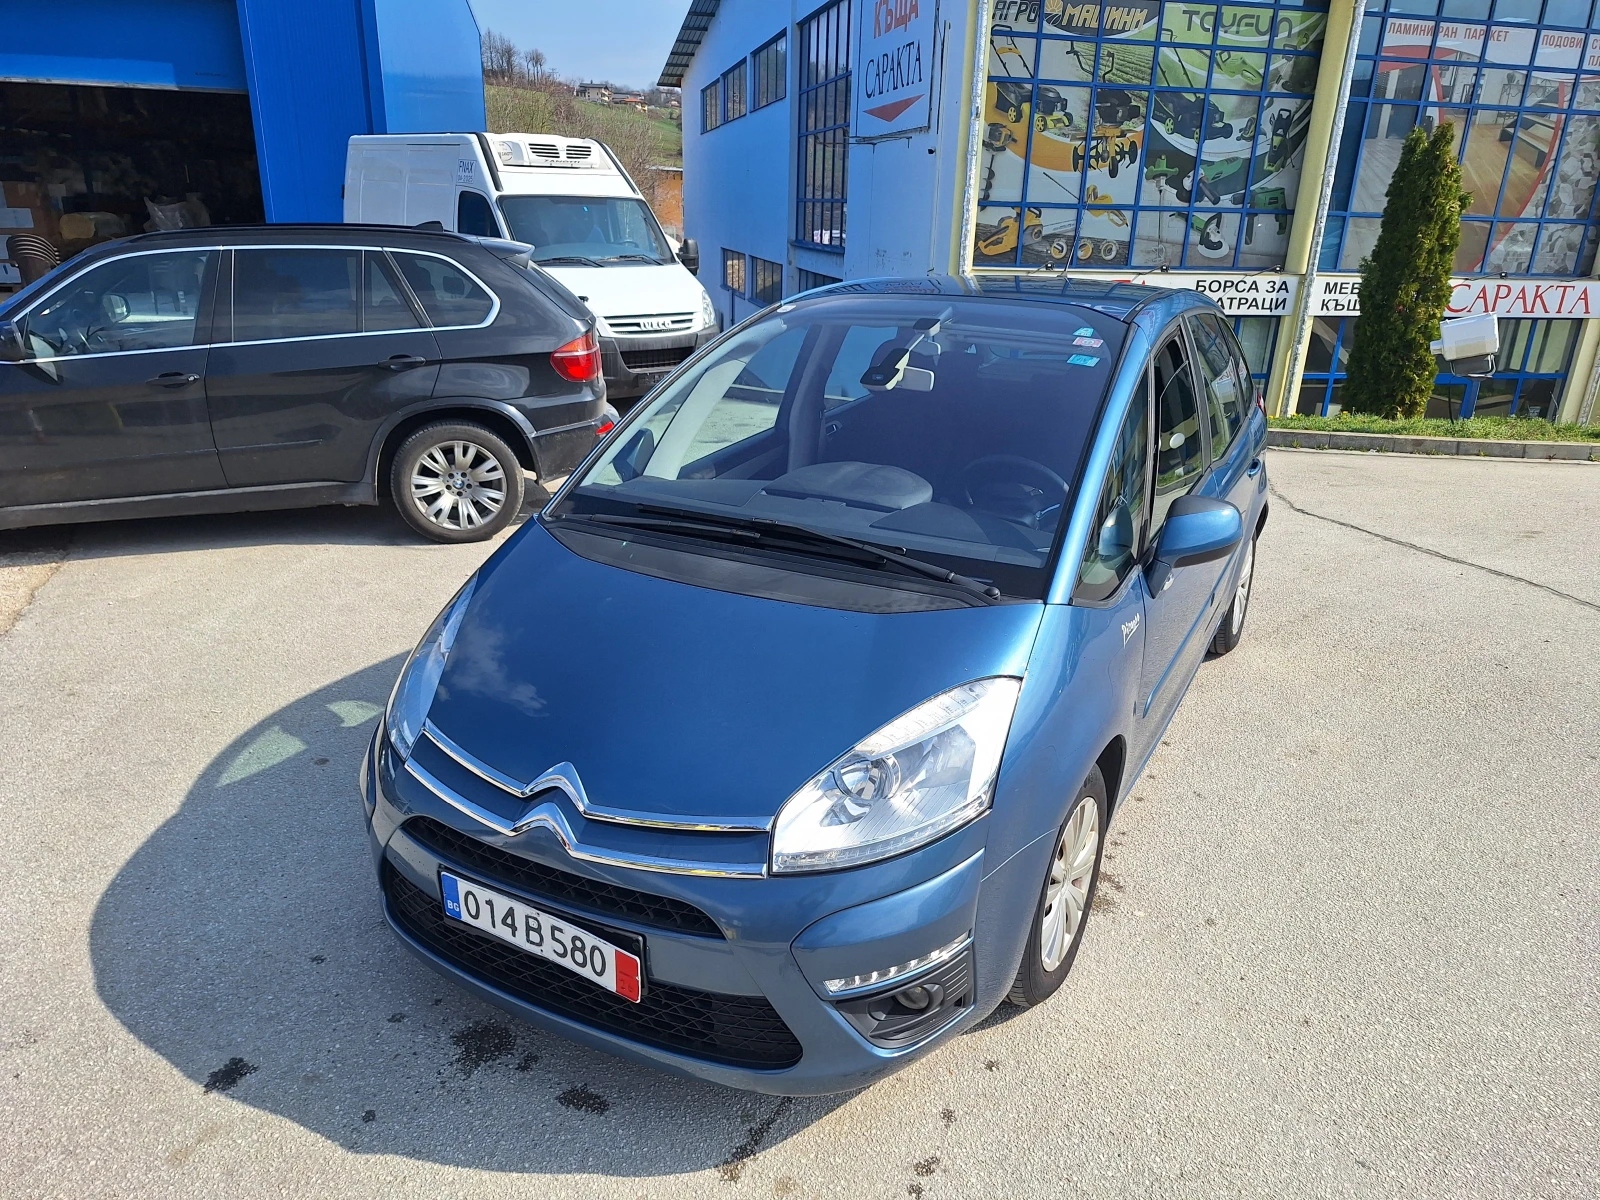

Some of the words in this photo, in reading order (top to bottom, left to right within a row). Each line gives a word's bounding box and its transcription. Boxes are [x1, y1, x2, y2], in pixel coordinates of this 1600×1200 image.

[992, 0, 1040, 23] АГРО
[1061, 3, 1148, 31] МАШИНИ
[1388, 22, 1458, 39] ЛАМИНИРАН
[1463, 27, 1510, 42] ПАРКЕТ
[1541, 34, 1583, 49] ПОДОВИ
[865, 40, 922, 98] САРАКТА
[1195, 279, 1260, 294] БОРСА
[1265, 280, 1290, 294] ЗА
[1216, 297, 1287, 313] АТРАЦИ
[1444, 283, 1591, 315] САРАКТА
[640, 319, 672, 330] IVECO
[447, 900, 460, 912] BG
